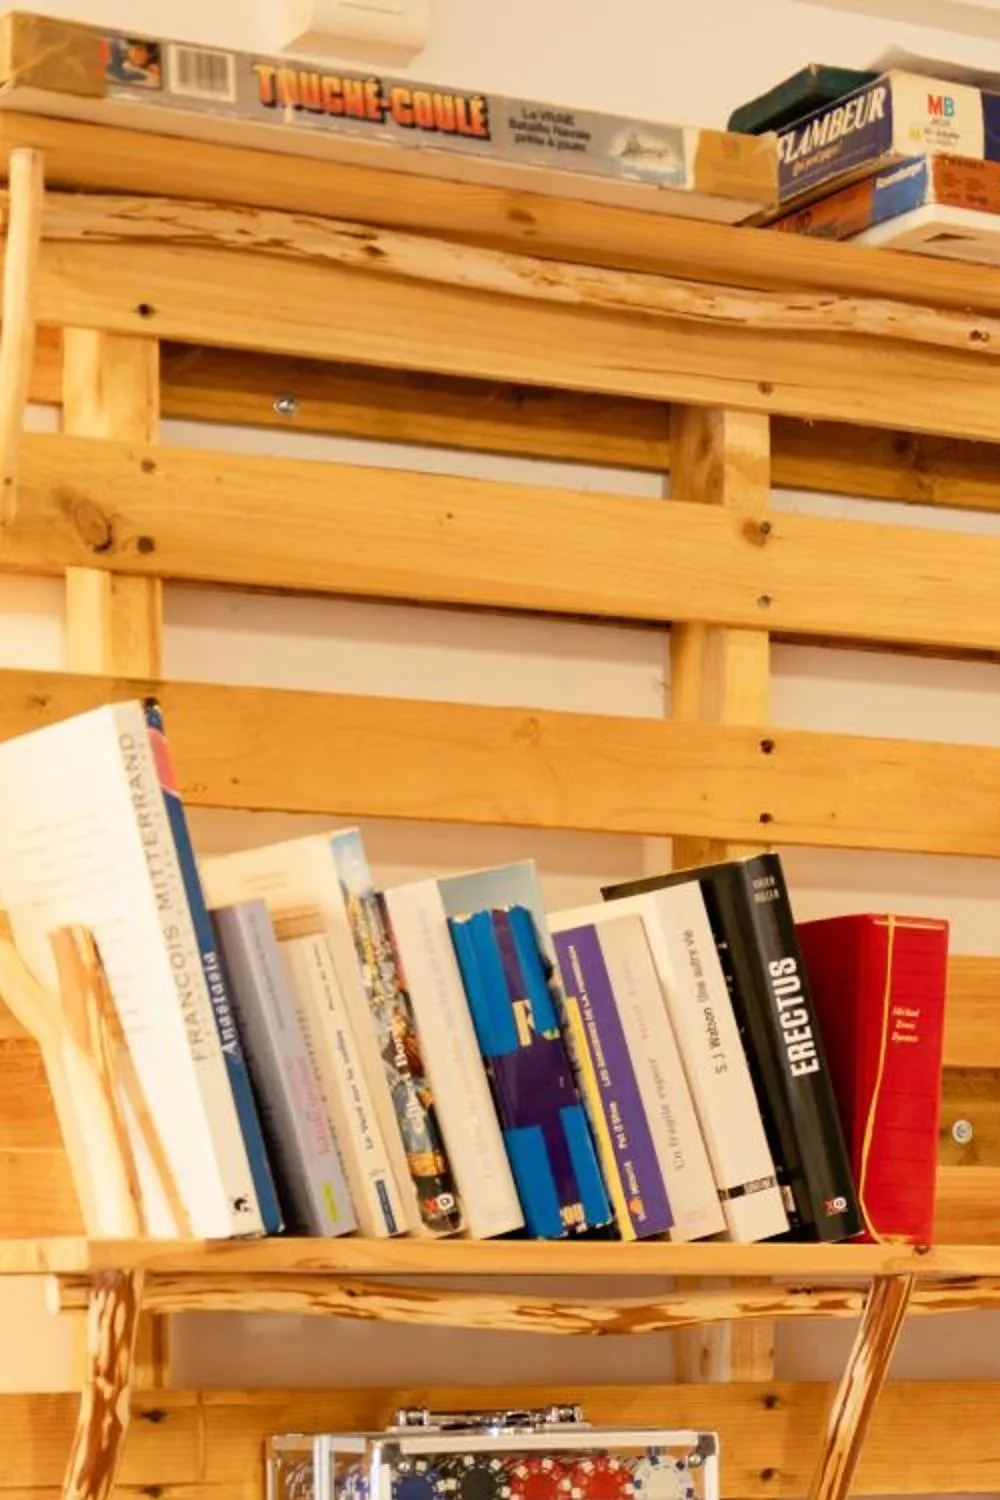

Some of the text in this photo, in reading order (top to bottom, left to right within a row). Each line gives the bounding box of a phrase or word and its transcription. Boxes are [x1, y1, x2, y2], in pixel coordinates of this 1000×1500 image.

[778, 86, 887, 164] FLAMBEUR
[927, 94, 954, 117] MB
[118, 733, 176, 911] MITTERRAND
[203, 951, 238, 1056] Anastasia
[697, 1005, 723, 1050] Watson
[769, 957, 820, 1077] ERECTUS
